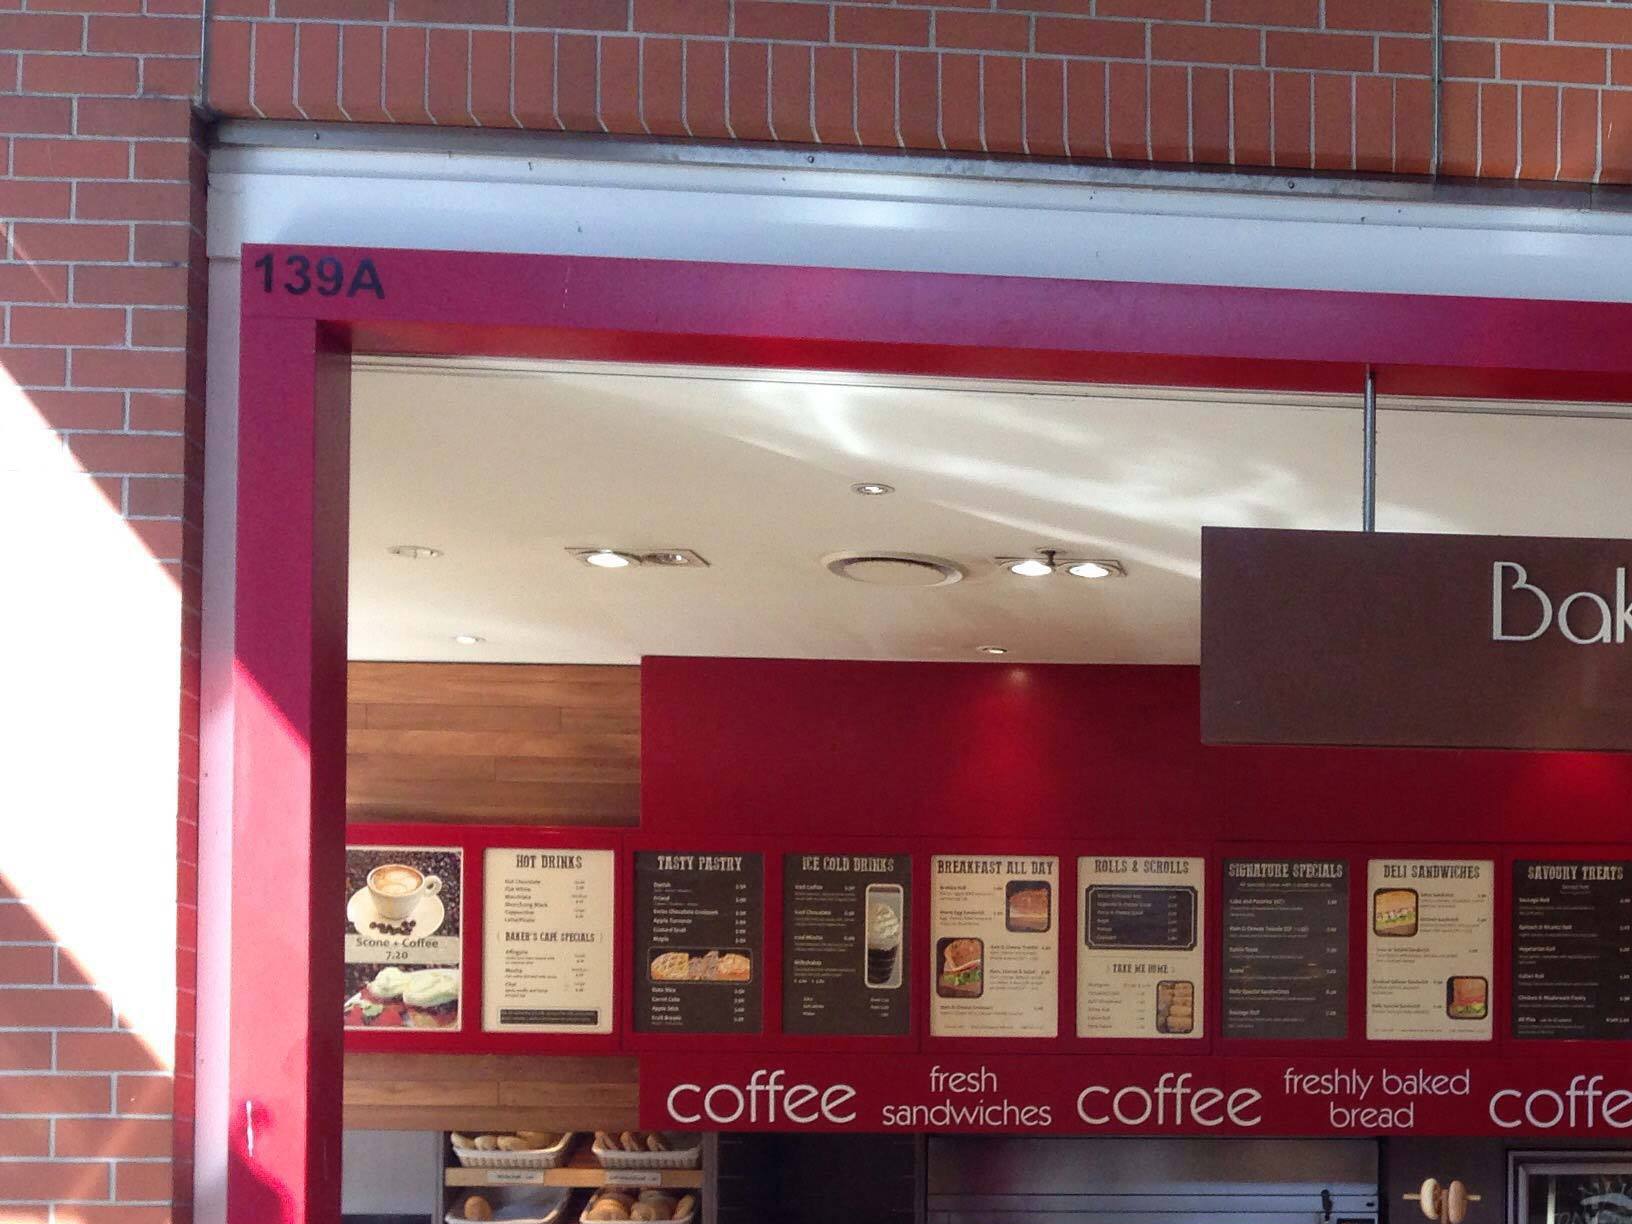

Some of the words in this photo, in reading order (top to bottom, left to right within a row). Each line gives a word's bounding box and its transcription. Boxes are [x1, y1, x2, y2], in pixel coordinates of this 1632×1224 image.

[254, 252, 386, 300] 139A
[516, 854, 536, 869] HOT
[541, 855, 583, 869] DRINKS
[658, 855, 694, 871] TASTY
[698, 856, 742, 871] PASTRY
[802, 856, 820, 872] ICE
[823, 856, 849, 872] COLD
[853, 857, 895, 873] DRINKS
[937, 859, 1003, 874] BREAKFAST
[1006, 860, 1028, 875] ALL
[1031, 860, 1054, 875] DAY
[1094, 859, 1127, 874] ROLLS
[1131, 860, 1139, 874] &
[1143, 860, 1190, 875] SCROLLS
[1228, 863, 1289, 878] SIGNATURE
[1293, 863, 1343, 879] SPECIALS
[1383, 864, 1408, 879] DELI
[1411, 864, 1481, 880] SANDWICHES
[1528, 865, 1577, 881] SAVOURY
[1582, 866, 1624, 881] TREATS
[355, 937, 390, 949] Scone
[402, 937, 439, 949] Coffee
[561, 932, 595, 943] SPECIALS
[1113, 963, 1132, 974] TAKE
[929, 1065, 998, 1093] fresh
[1284, 1066, 1374, 1099] freshly
[1381, 1067, 1470, 1096] baked
[666, 1069, 857, 1125] coffee
[1076, 1072, 1263, 1127] coffee
[882, 1098, 1052, 1127] sandwiches
[1329, 1100, 1414, 1129] bread
